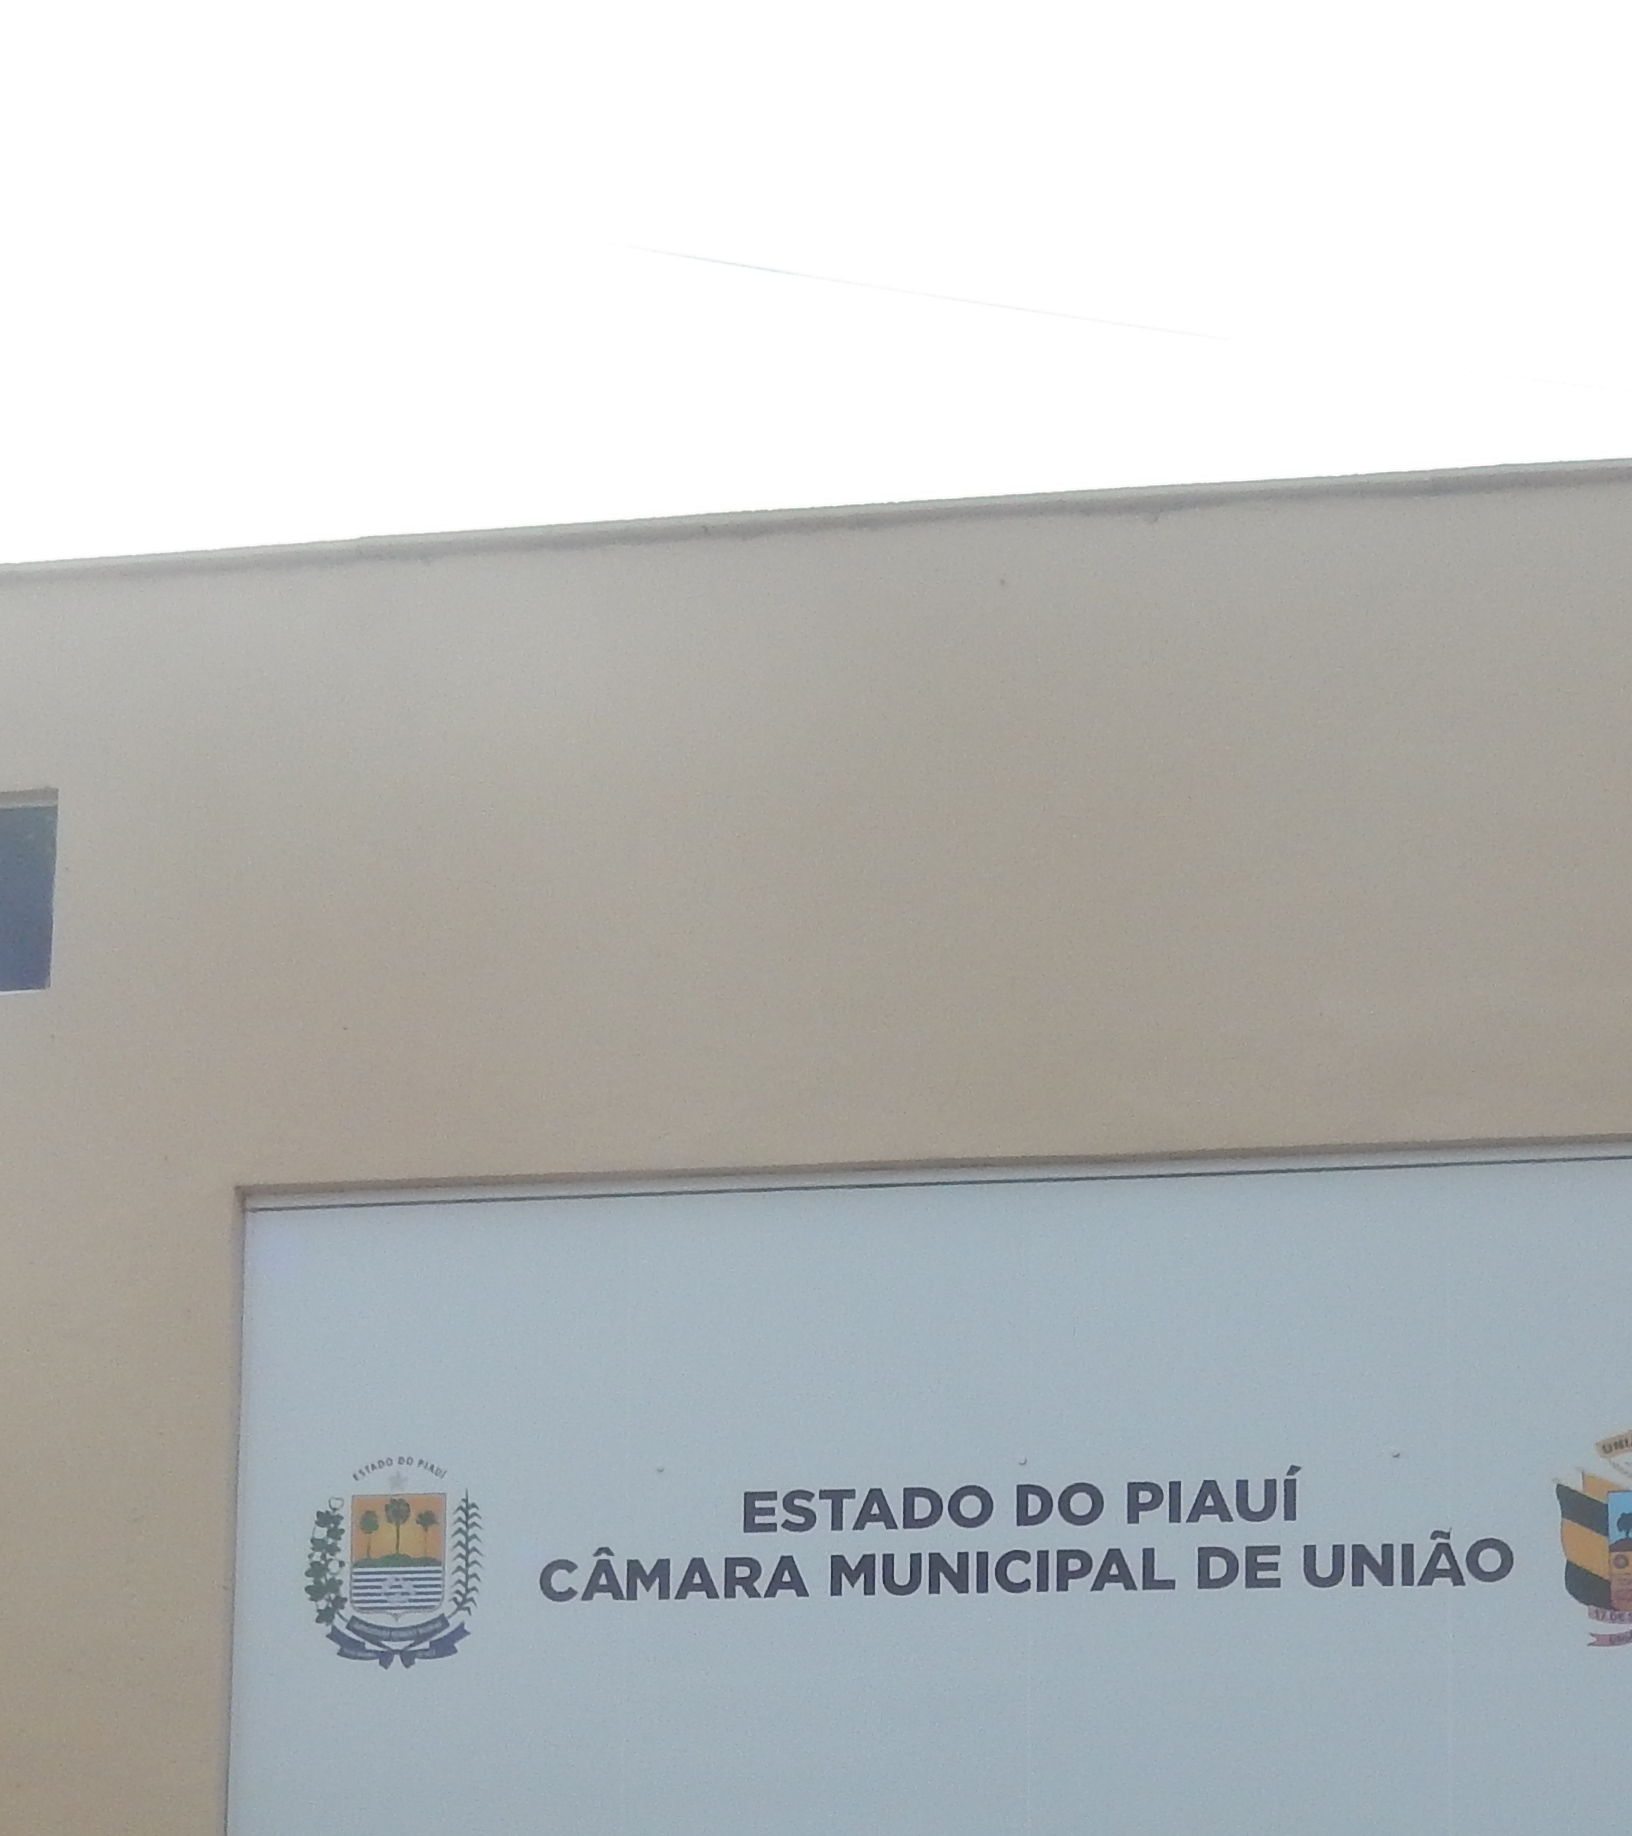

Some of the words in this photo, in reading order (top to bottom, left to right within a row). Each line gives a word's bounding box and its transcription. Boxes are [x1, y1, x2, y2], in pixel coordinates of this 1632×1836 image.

[352, 1456, 394, 1482] ESTADO
[397, 1455, 414, 1467] DO
[743, 1484, 994, 1534] ESTADO
[1016, 1482, 1105, 1527] DO
[1126, 1464, 1302, 1525] PIAUÍ
[539, 1546, 810, 1603] CÂMARA
[830, 1547, 1176, 1597] MUNICIPAL
[1197, 1545, 1282, 1590] DE
[1303, 1529, 1514, 1589] UNIÃO
